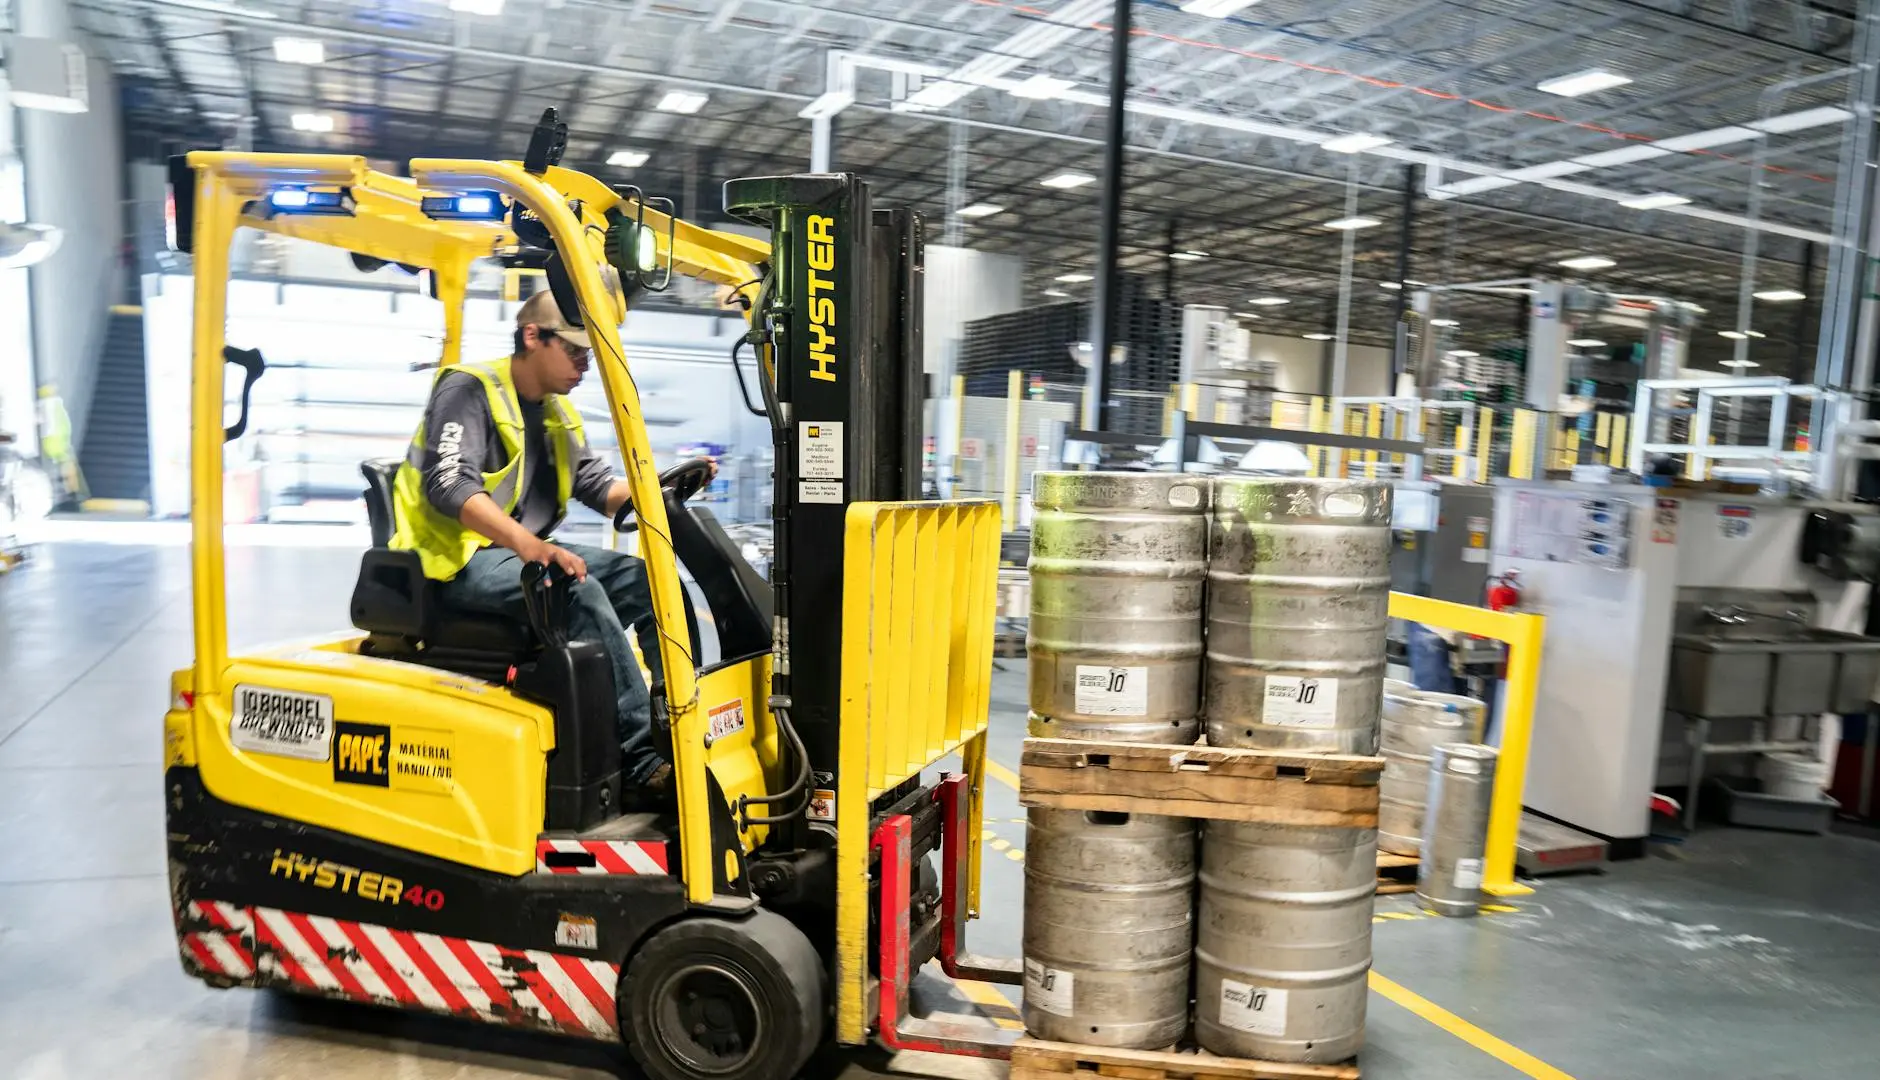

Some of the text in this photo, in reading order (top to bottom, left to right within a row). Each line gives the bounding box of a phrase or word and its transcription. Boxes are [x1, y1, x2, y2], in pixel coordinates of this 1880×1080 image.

[807, 214, 837, 382] HYSTER
[1106, 672, 1125, 692] 10
[1296, 683, 1316, 704] 10
[399, 743, 451, 760] MATERIAL
[397, 761, 452, 778] HANDLING
[270, 848, 445, 911] HYSTER 40
